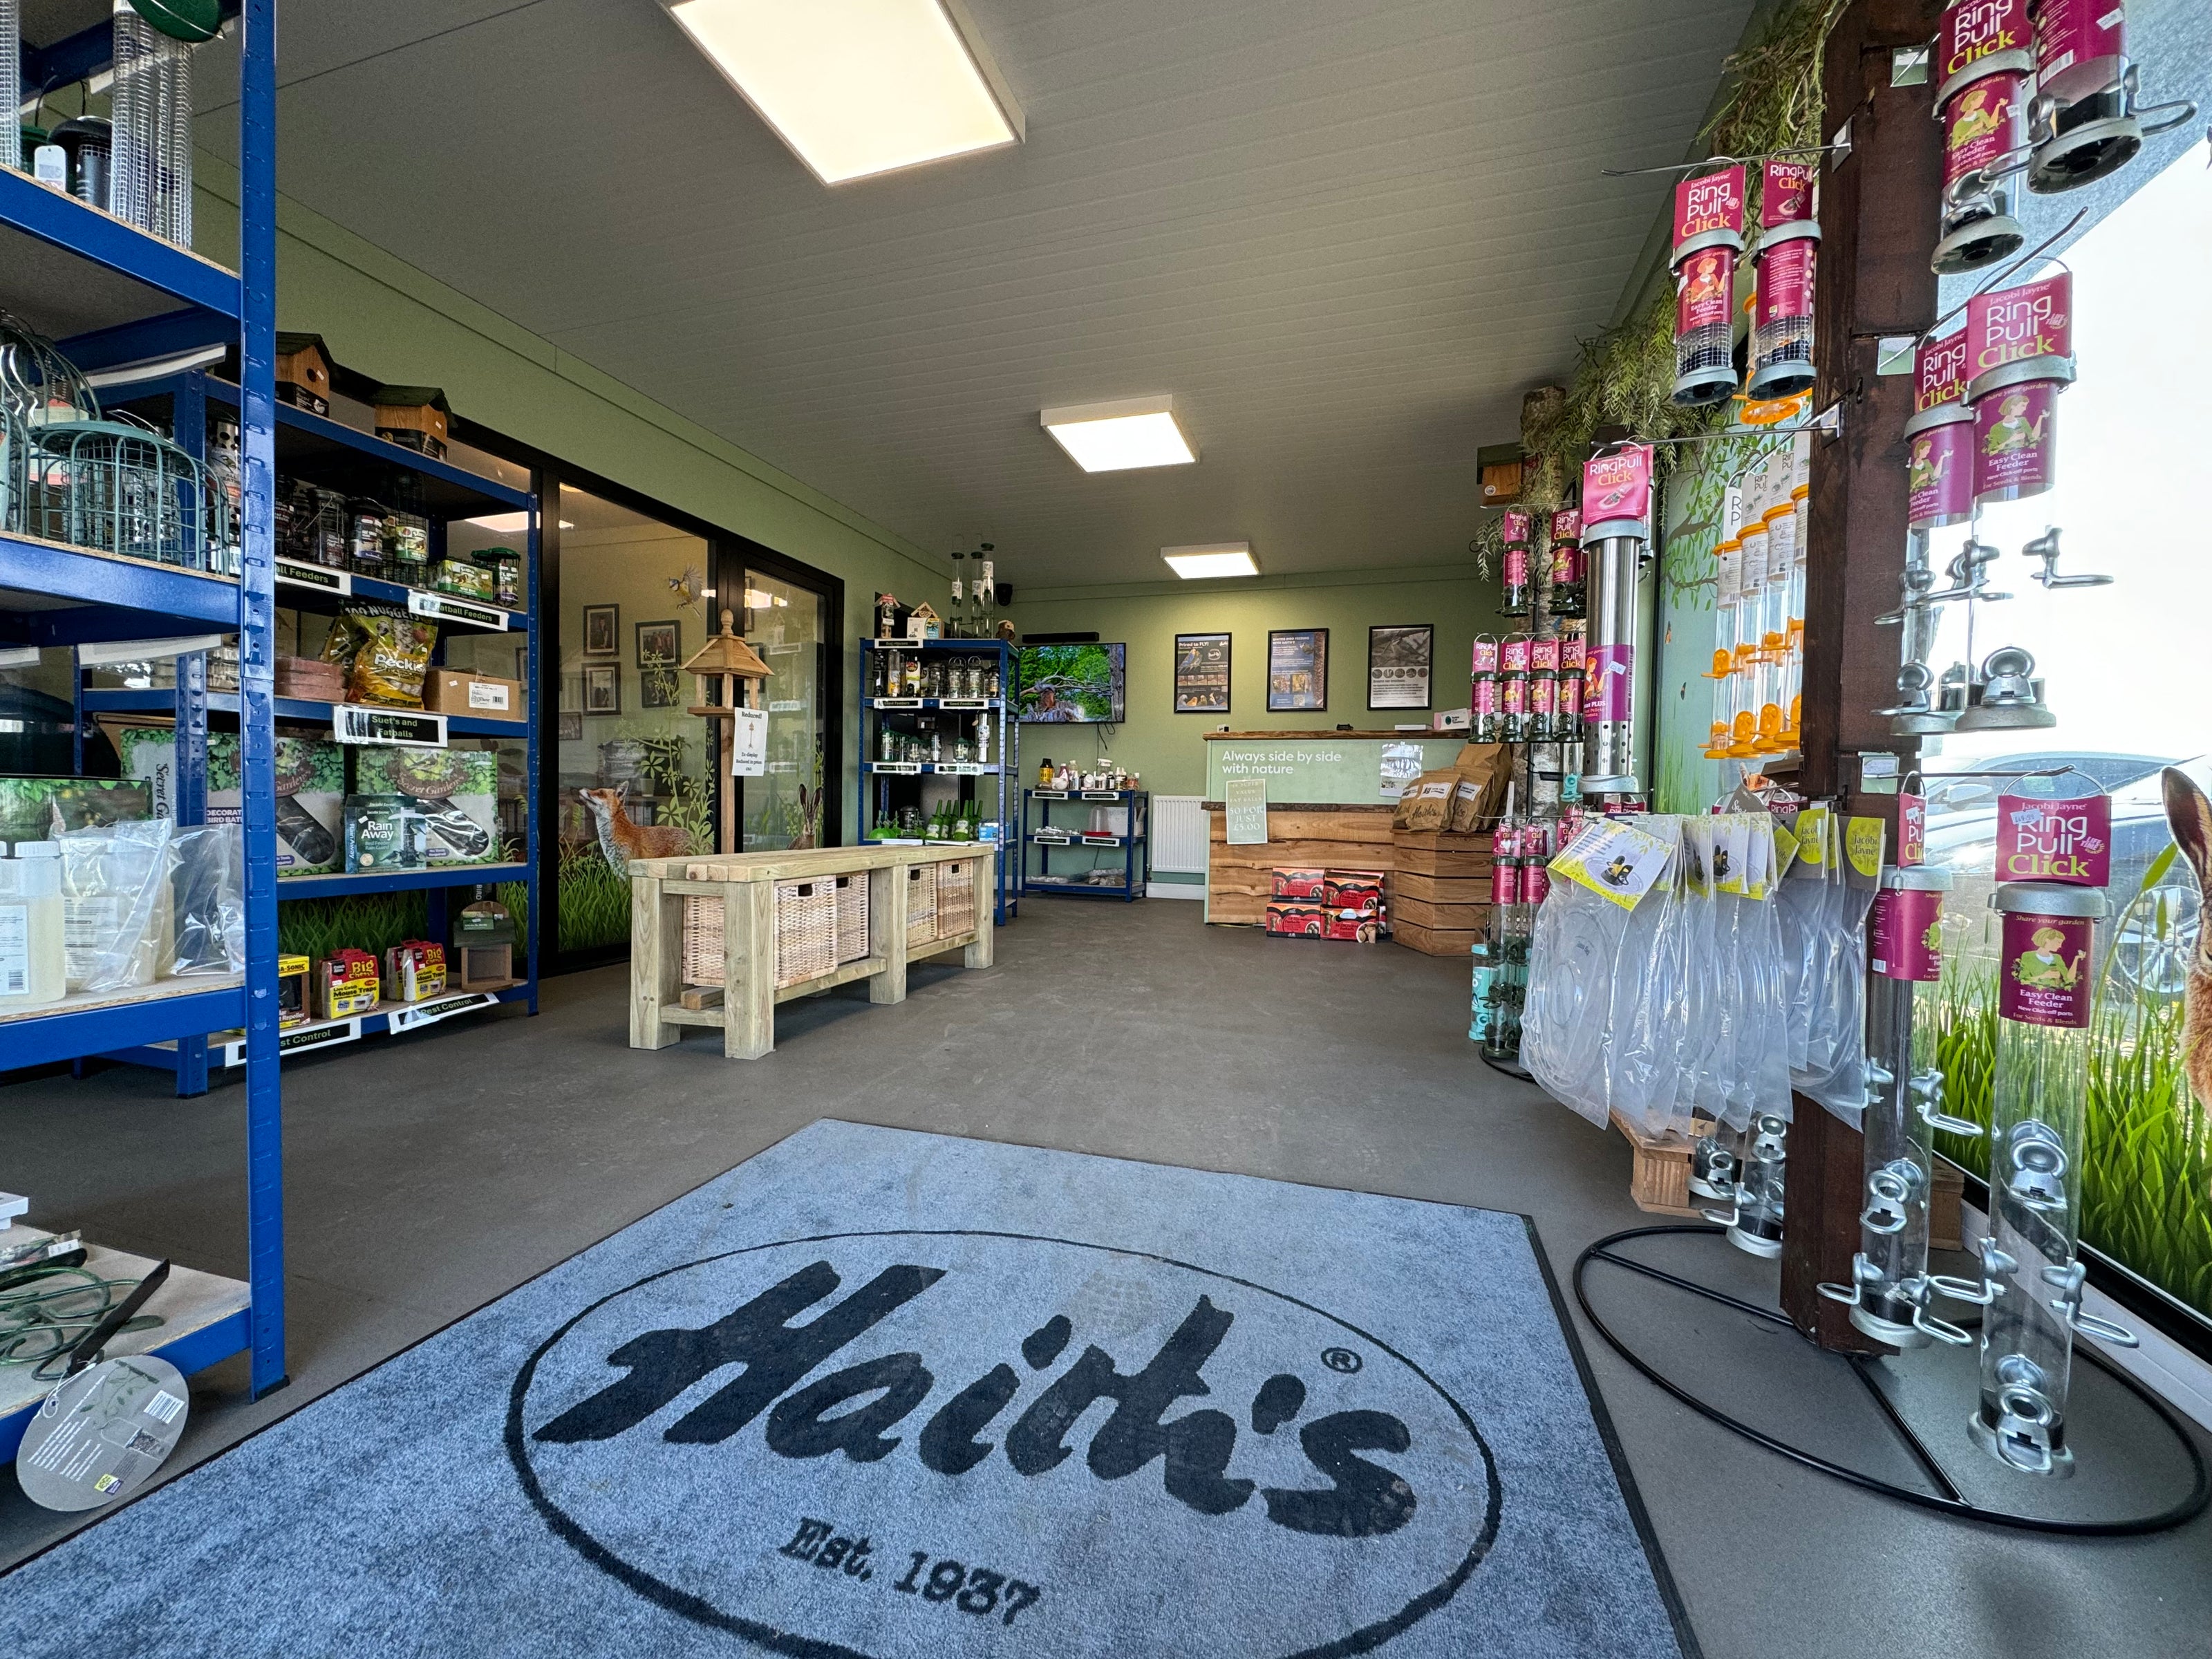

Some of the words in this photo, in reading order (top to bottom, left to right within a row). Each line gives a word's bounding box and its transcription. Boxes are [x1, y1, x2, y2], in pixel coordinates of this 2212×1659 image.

[1955, 0, 2013, 36] Ring
[1954, 14, 2000, 55] Pull
[1947, 30, 2016, 75] Click
[1970, 136, 1996, 149] Clean
[1958, 145, 1987, 162] Feeder
[1691, 177, 1712, 189] Jacobi
[1712, 172, 1731, 184] Jayne
[1779, 177, 1806, 194] Click
[1688, 182, 1731, 206] Ring
[1687, 198, 1721, 221] Pull
[1681, 213, 1731, 238] Click
[1990, 289, 2020, 306] Jacobi
[2023, 282, 2052, 296] Jayne
[1691, 303, 1706, 311] Easy
[1696, 306, 1718, 315] Feeder
[1987, 295, 2052, 328] Ring
[1986, 315, 2038, 347] Pull
[1925, 339, 1944, 357] Jacobi
[1944, 332, 1966, 346] Jayne
[1978, 335, 2054, 368] Click
[1923, 342, 1966, 377] Ring
[1923, 362, 1956, 394] Pull
[1918, 378, 1966, 413] Click
[1985, 391, 2003, 402] Share
[2004, 385, 2021, 397] your
[2023, 382, 2049, 393] garden
[1590, 454, 1642, 477] RingPull
[1988, 456, 2012, 467] Easy
[2011, 451, 2038, 462] Clean
[1996, 459, 2030, 471] Feeder
[1597, 470, 1633, 487] Click
[1918, 489, 1938, 499] Clean
[1556, 523, 1572, 532] Pull
[1557, 516, 1575, 527] Ring
[1554, 529, 1576, 541] Click
[289, 567, 329, 583] Feeders
[464, 608, 492, 622] Feeders
[1506, 647, 1525, 657] Ring
[1533, 646, 1553, 657] Ring
[1563, 645, 1582, 655] Ring
[1505, 654, 1521, 664] Pull
[1531, 659, 1553, 669] Click
[1533, 653, 1550, 662] Pull
[1563, 653, 1577, 662] Pull
[1503, 662, 1524, 671] Click
[1561, 660, 1582, 669] Click
[371, 715, 400, 726] Suet's
[402, 719, 418, 727] and
[378, 728, 413, 738] Fatballs
[1222, 751, 1266, 765] Always
[1268, 751, 1294, 762] side
[1297, 751, 1312, 765] by
[1315, 751, 1342, 762] side
[1222, 763, 1248, 774] with
[1252, 765, 1294, 774] nature
[1229, 807, 1240, 816] 50
[1244, 806, 1265, 814] FOR
[2022, 802, 2054, 812] Jacobi
[2056, 803, 2086, 813] Jayne
[368, 821, 393, 831] Rain
[1234, 823, 1261, 831] £5.00
[361, 830, 394, 841] Away
[1854, 834, 1877, 845] Jacobi
[2088, 836, 2103, 845] LIFE
[2017, 833, 2072, 854] Pull
[1855, 845, 1876, 857] Jayne
[2007, 854, 2089, 878] Click
[427, 948, 442, 959] Big
[351, 959, 375, 973] Big
[358, 986, 377, 994] Traps
[2020, 989, 2043, 1000] Easy
[2044, 991, 2074, 1002] Clean
[442, 998, 473, 1011] Control
[2028, 997, 2064, 1009] Feeder
[282, 1012, 306, 1022] Repeller
[2025, 1014, 2046, 1023] Seeds
[292, 1029, 332, 1044] Control
[532, 1259, 1417, 1539] Haith's
[780, 1517, 872, 1582] Est.
[893, 1550, 1041, 1627] 1937
